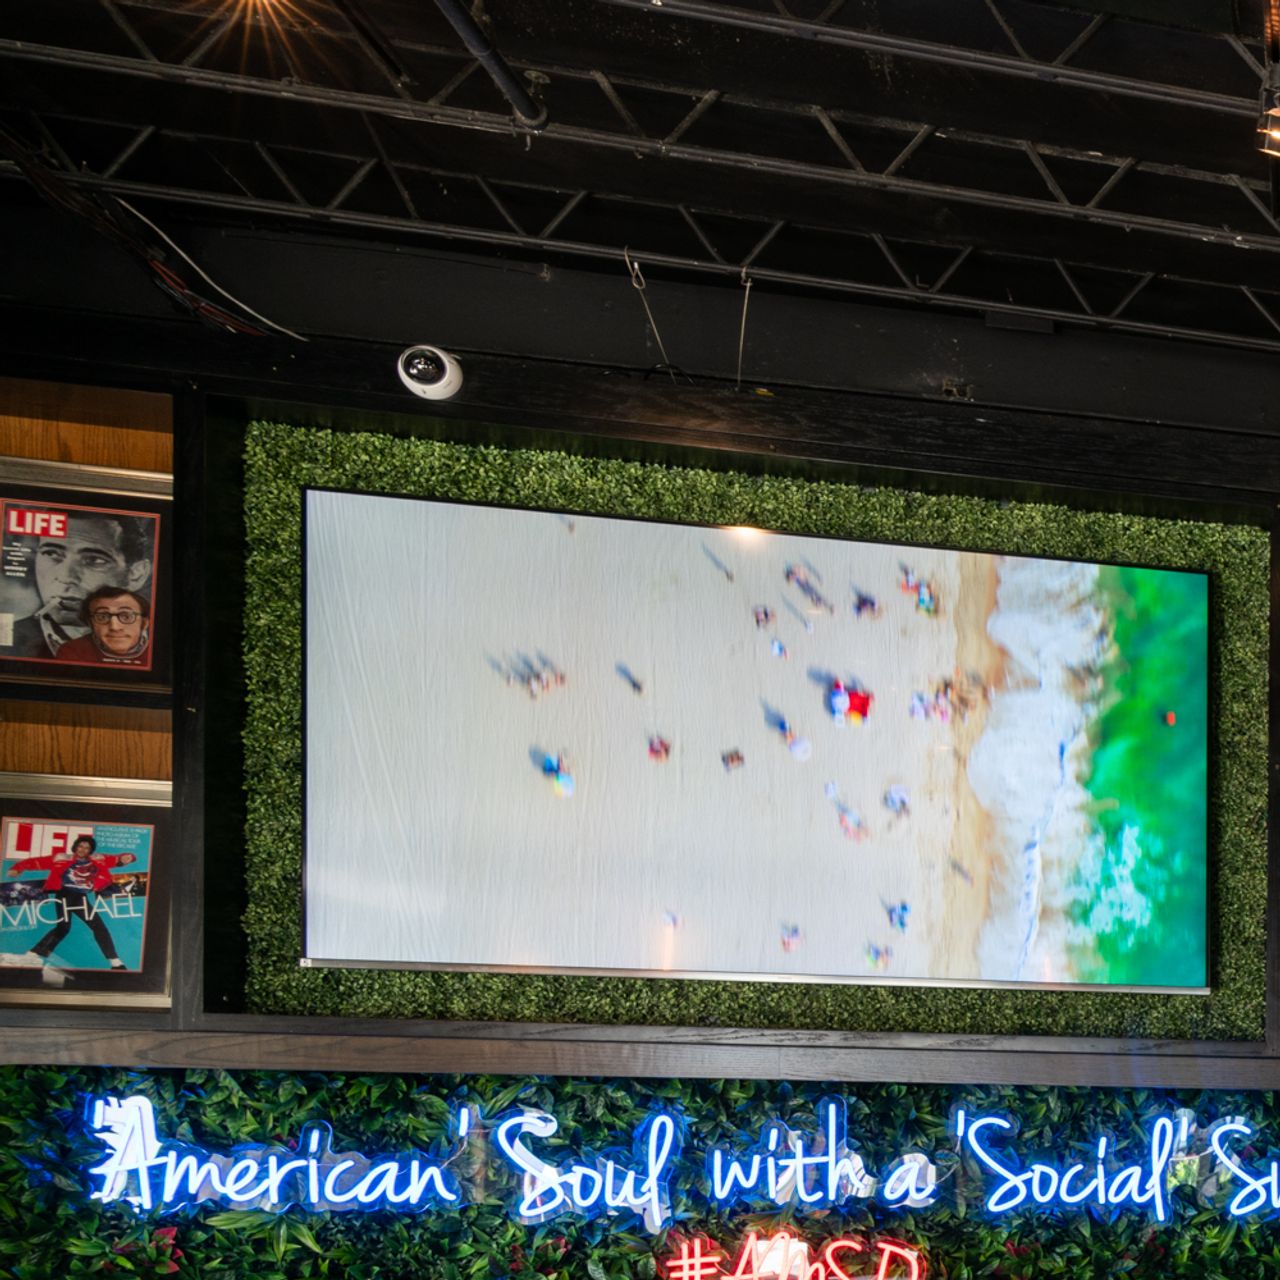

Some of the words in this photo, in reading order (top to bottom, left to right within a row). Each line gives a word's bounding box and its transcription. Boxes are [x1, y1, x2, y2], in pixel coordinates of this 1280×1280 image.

[8, 509, 67, 537] LIFE
[8, 823, 93, 859] LIFE
[0, 892, 142, 928] MICHAEL
[713, 1103, 866, 1203] with
[884, 1160, 936, 1202] a
